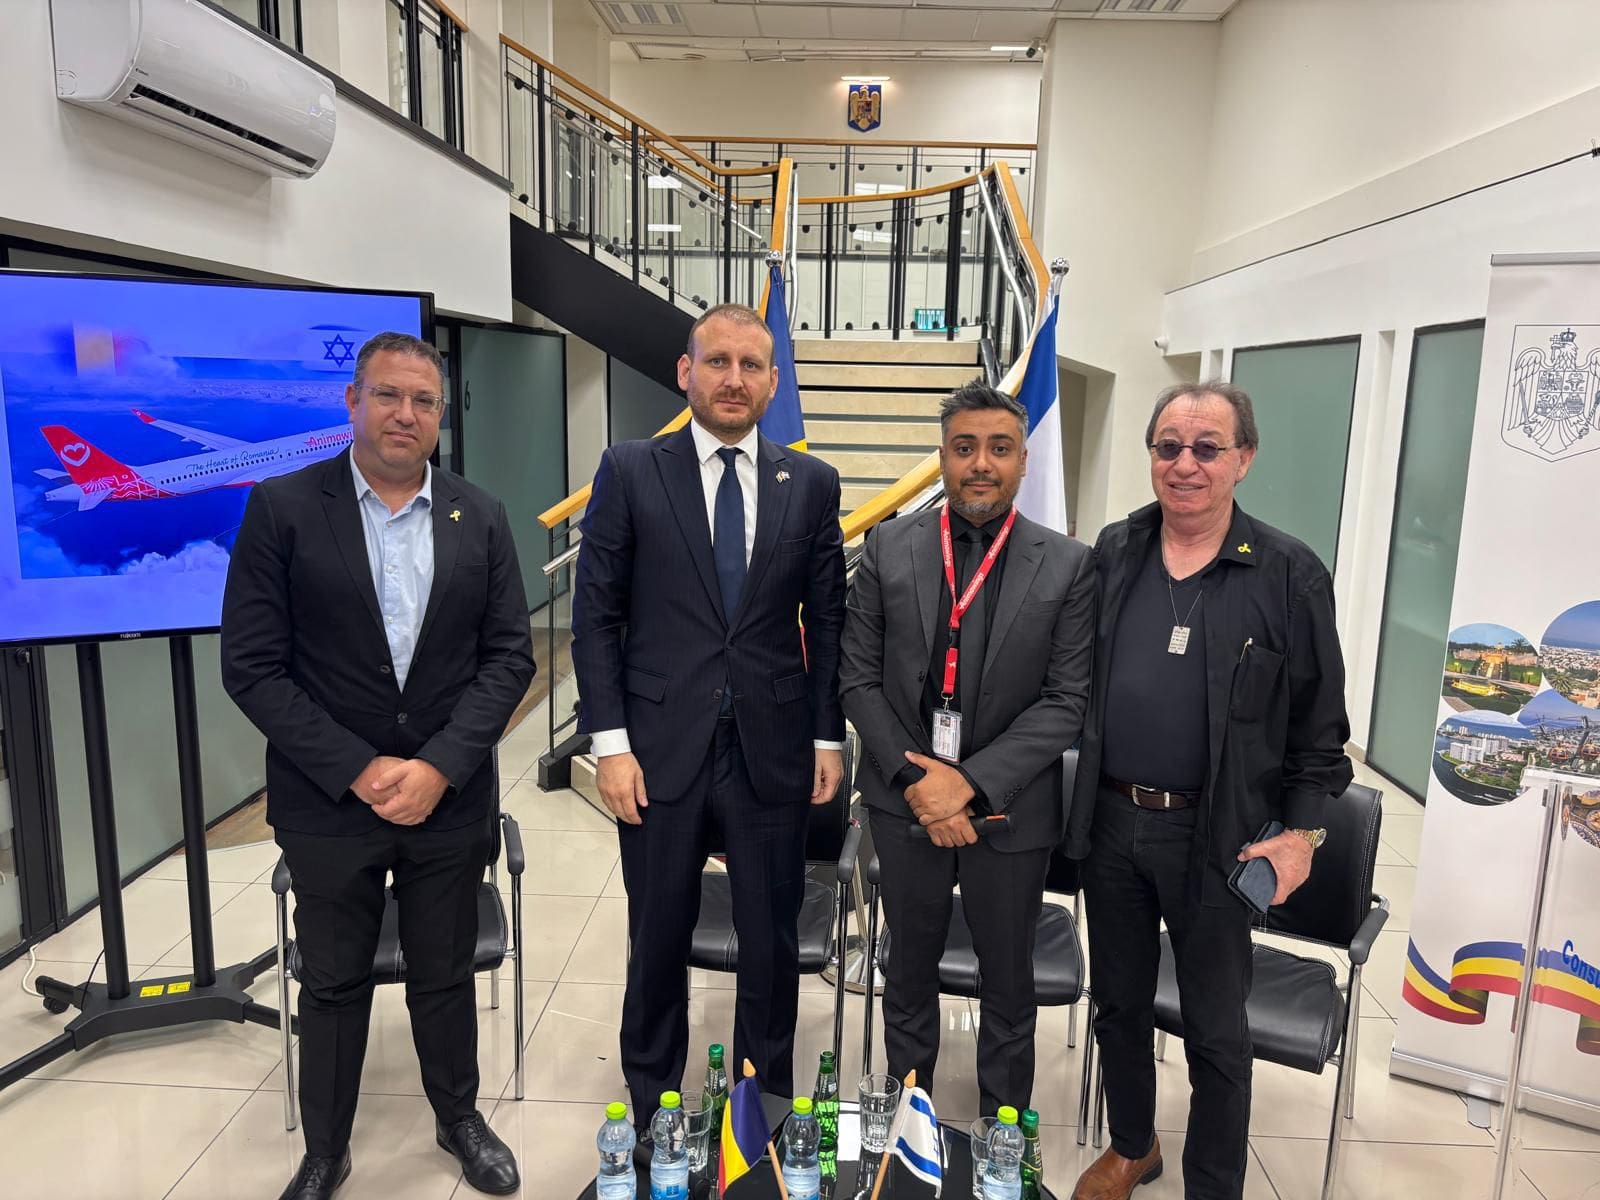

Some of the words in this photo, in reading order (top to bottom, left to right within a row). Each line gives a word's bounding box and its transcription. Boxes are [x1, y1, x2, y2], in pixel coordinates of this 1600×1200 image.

[186, 463, 204, 471] The
[206, 459, 228, 469] Heart
[230, 455, 238, 464] of
[240, 448, 279, 461] Romania
